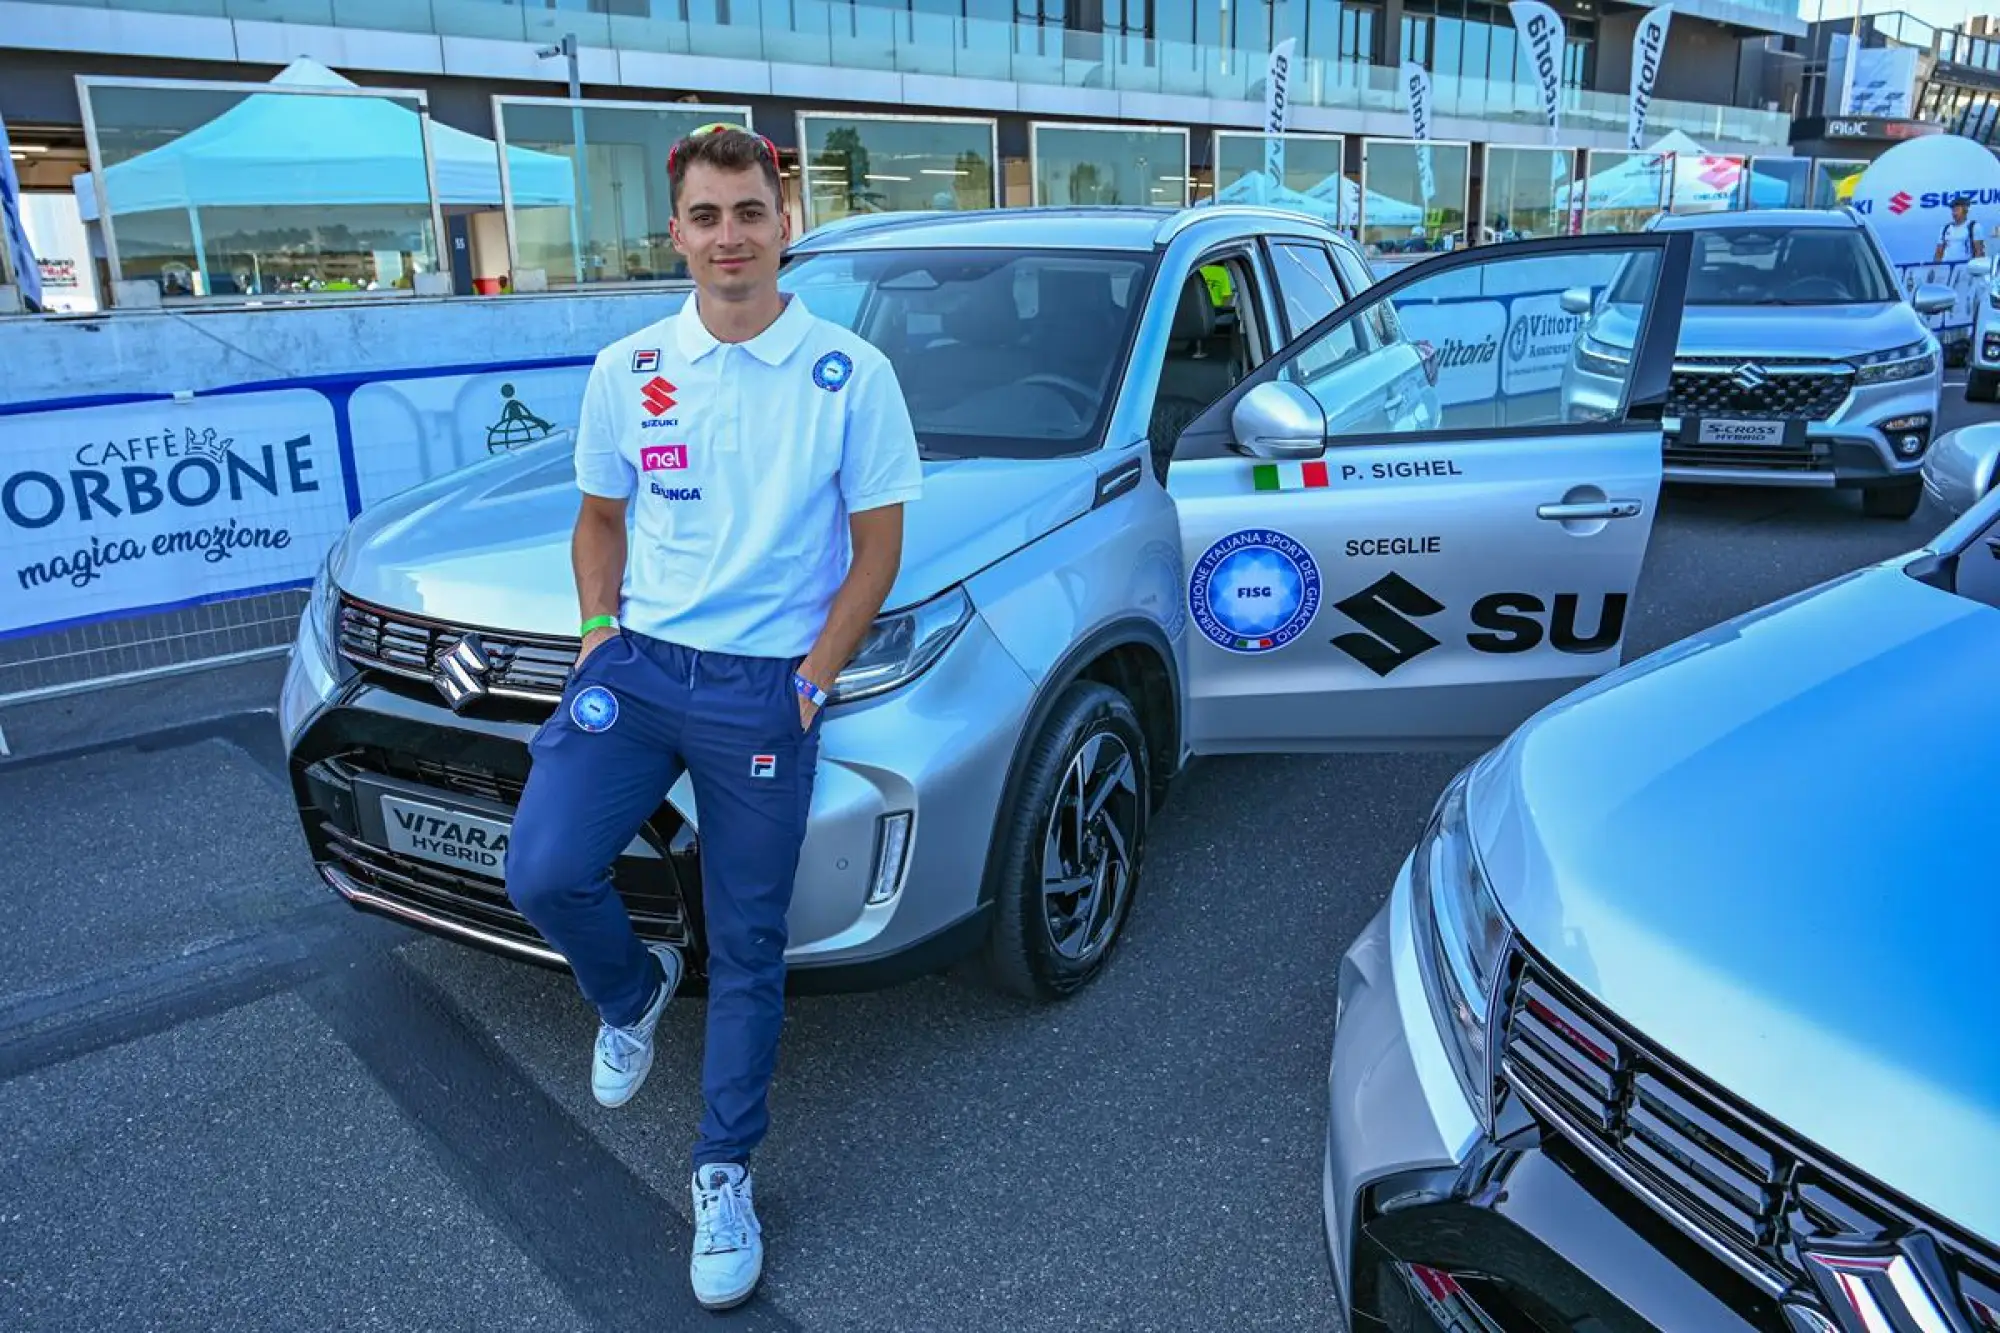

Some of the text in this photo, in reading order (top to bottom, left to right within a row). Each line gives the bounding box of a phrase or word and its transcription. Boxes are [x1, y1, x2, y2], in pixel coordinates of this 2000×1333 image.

[76, 428, 179, 467] CAFFÈ
[1, 433, 321, 529] ORBONE
[1341, 459, 1463, 480] P. SIGHEL
[17, 518, 291, 590] magica emozione
[1346, 536, 1441, 556] SCEGLIE
[1192, 532, 1318, 645] FEDERAZIONE ITALIANA SPORT DEL GHIACCIO
[1237, 587, 1272, 598] FISG
[1466, 592, 1628, 654] SU
[392, 807, 509, 851] VITARA
[411, 834, 498, 867] HYBRID
